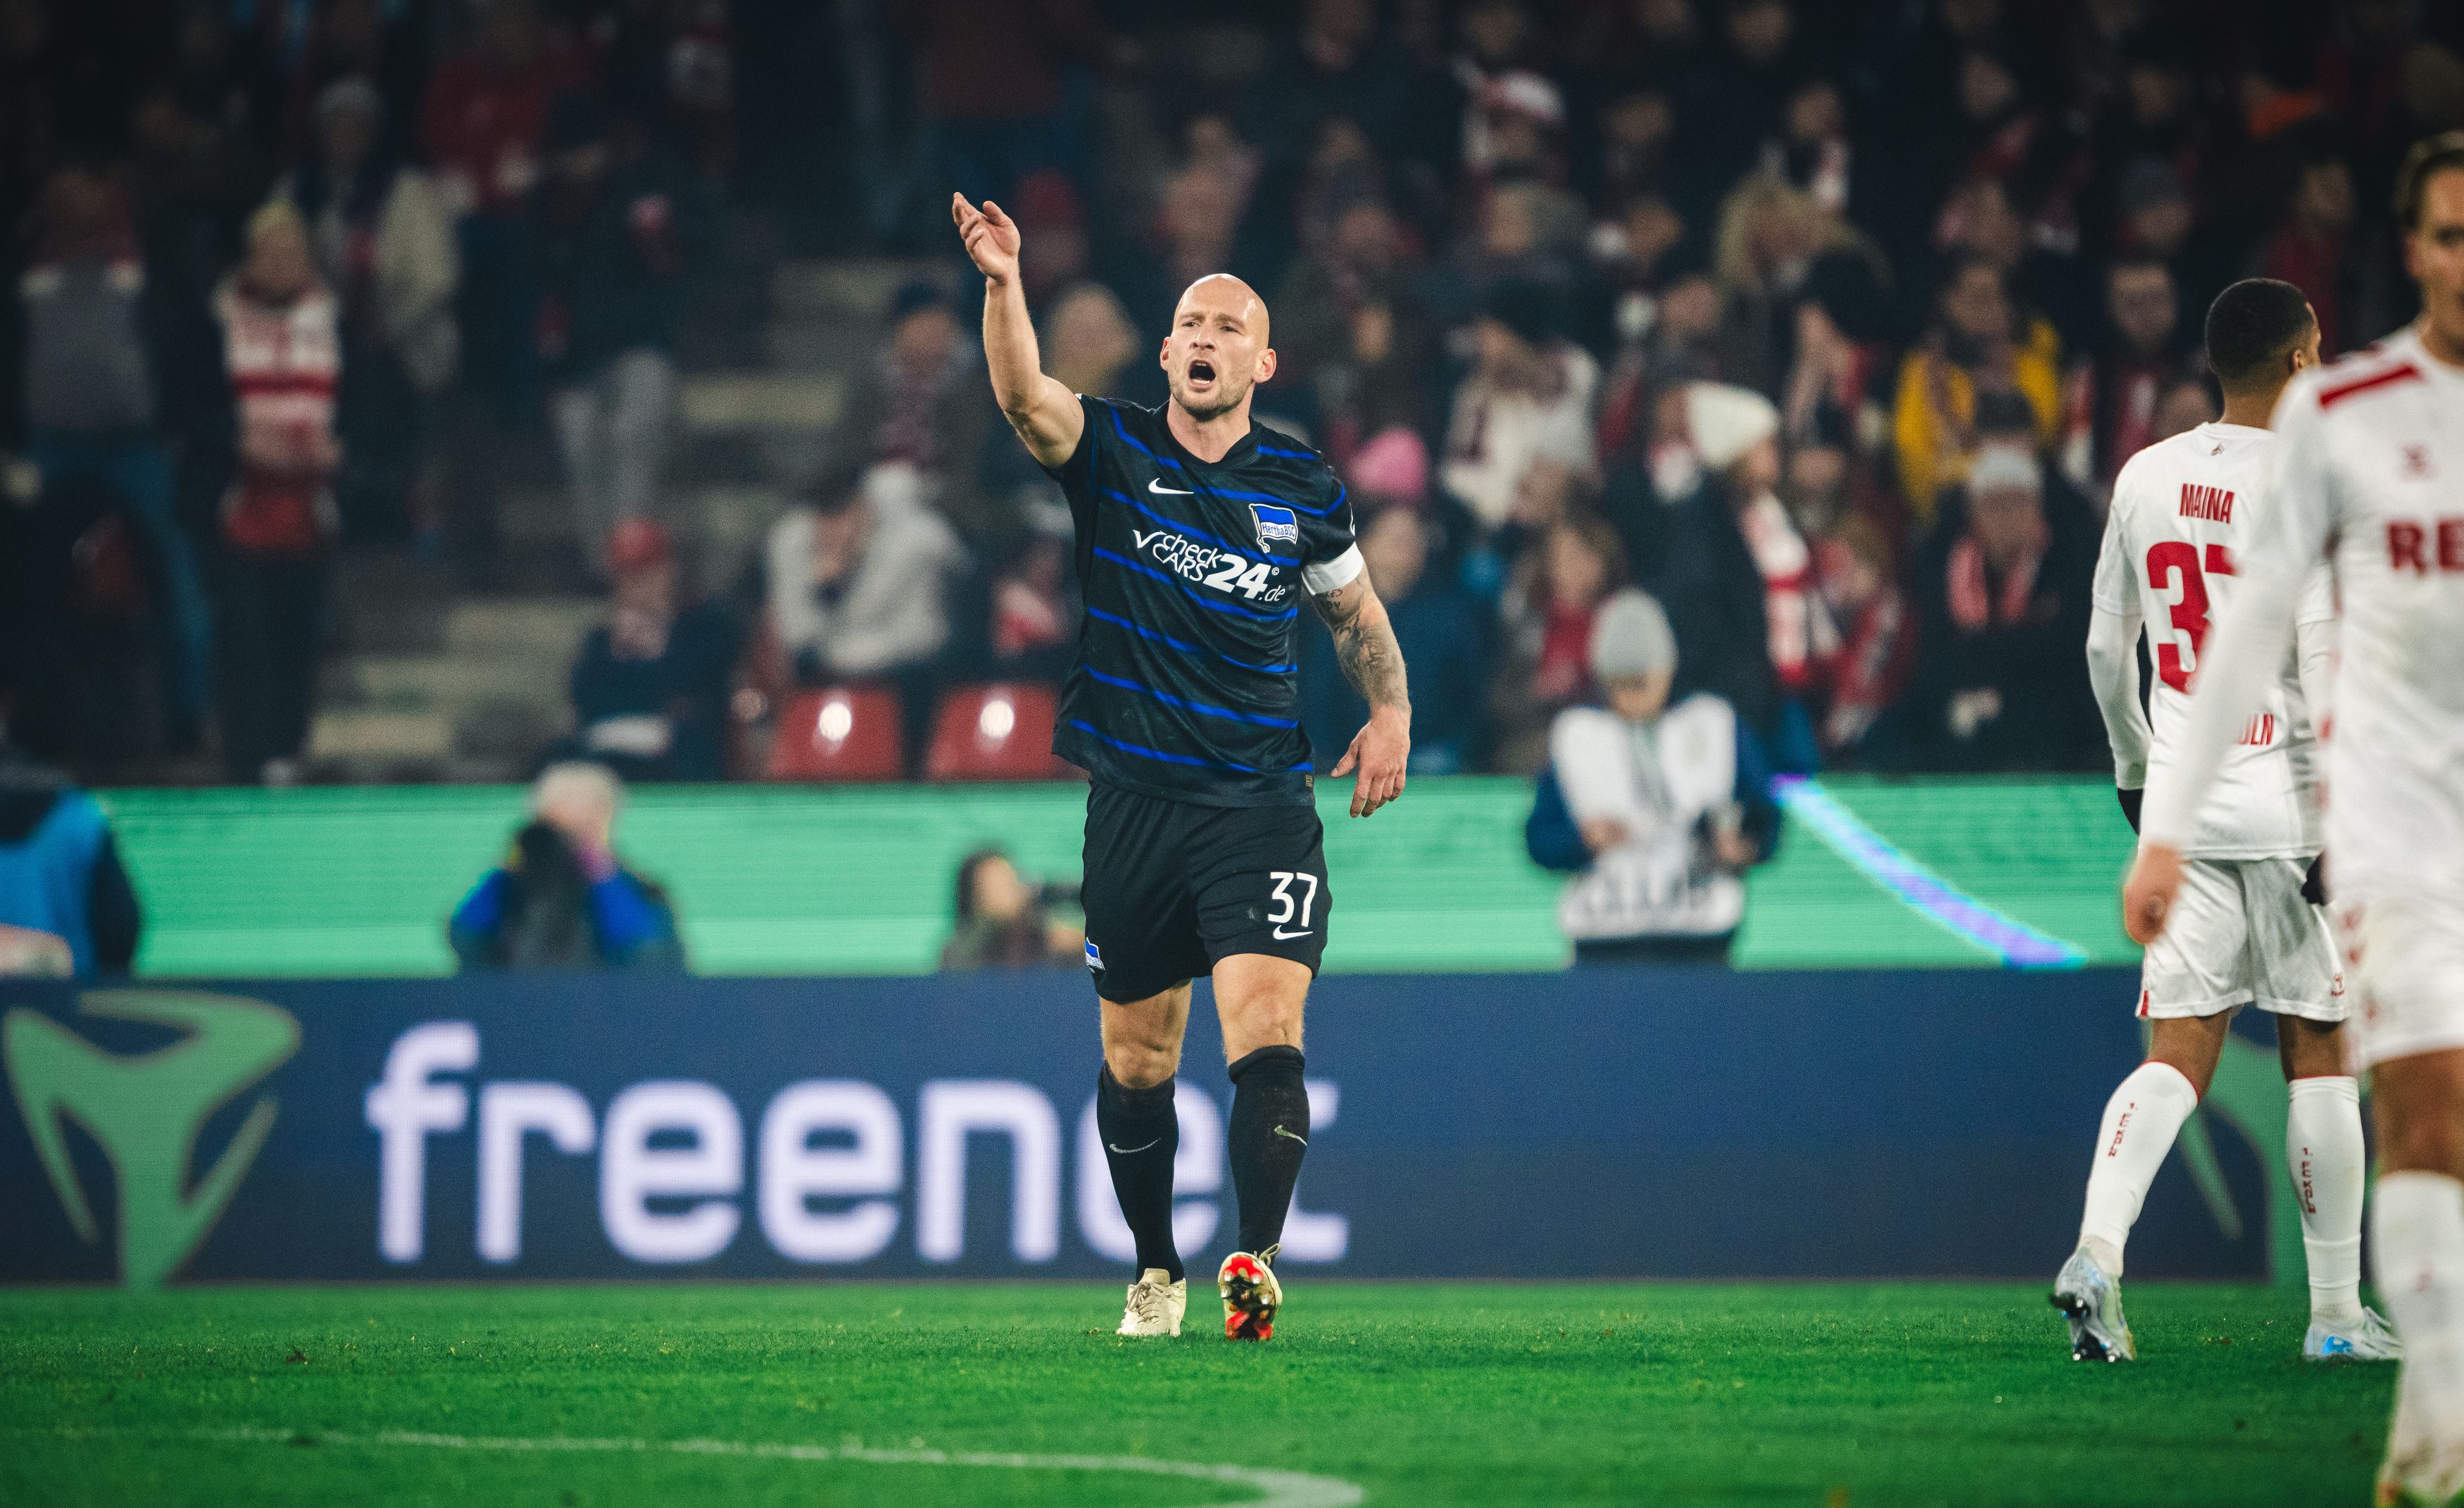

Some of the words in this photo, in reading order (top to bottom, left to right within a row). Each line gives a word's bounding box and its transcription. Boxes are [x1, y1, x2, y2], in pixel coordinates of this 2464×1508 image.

[1152, 543, 1209, 582] CARS
[1162, 534, 1223, 568] check
[2146, 541, 2242, 696] 3
[1268, 871, 1318, 927] 37
